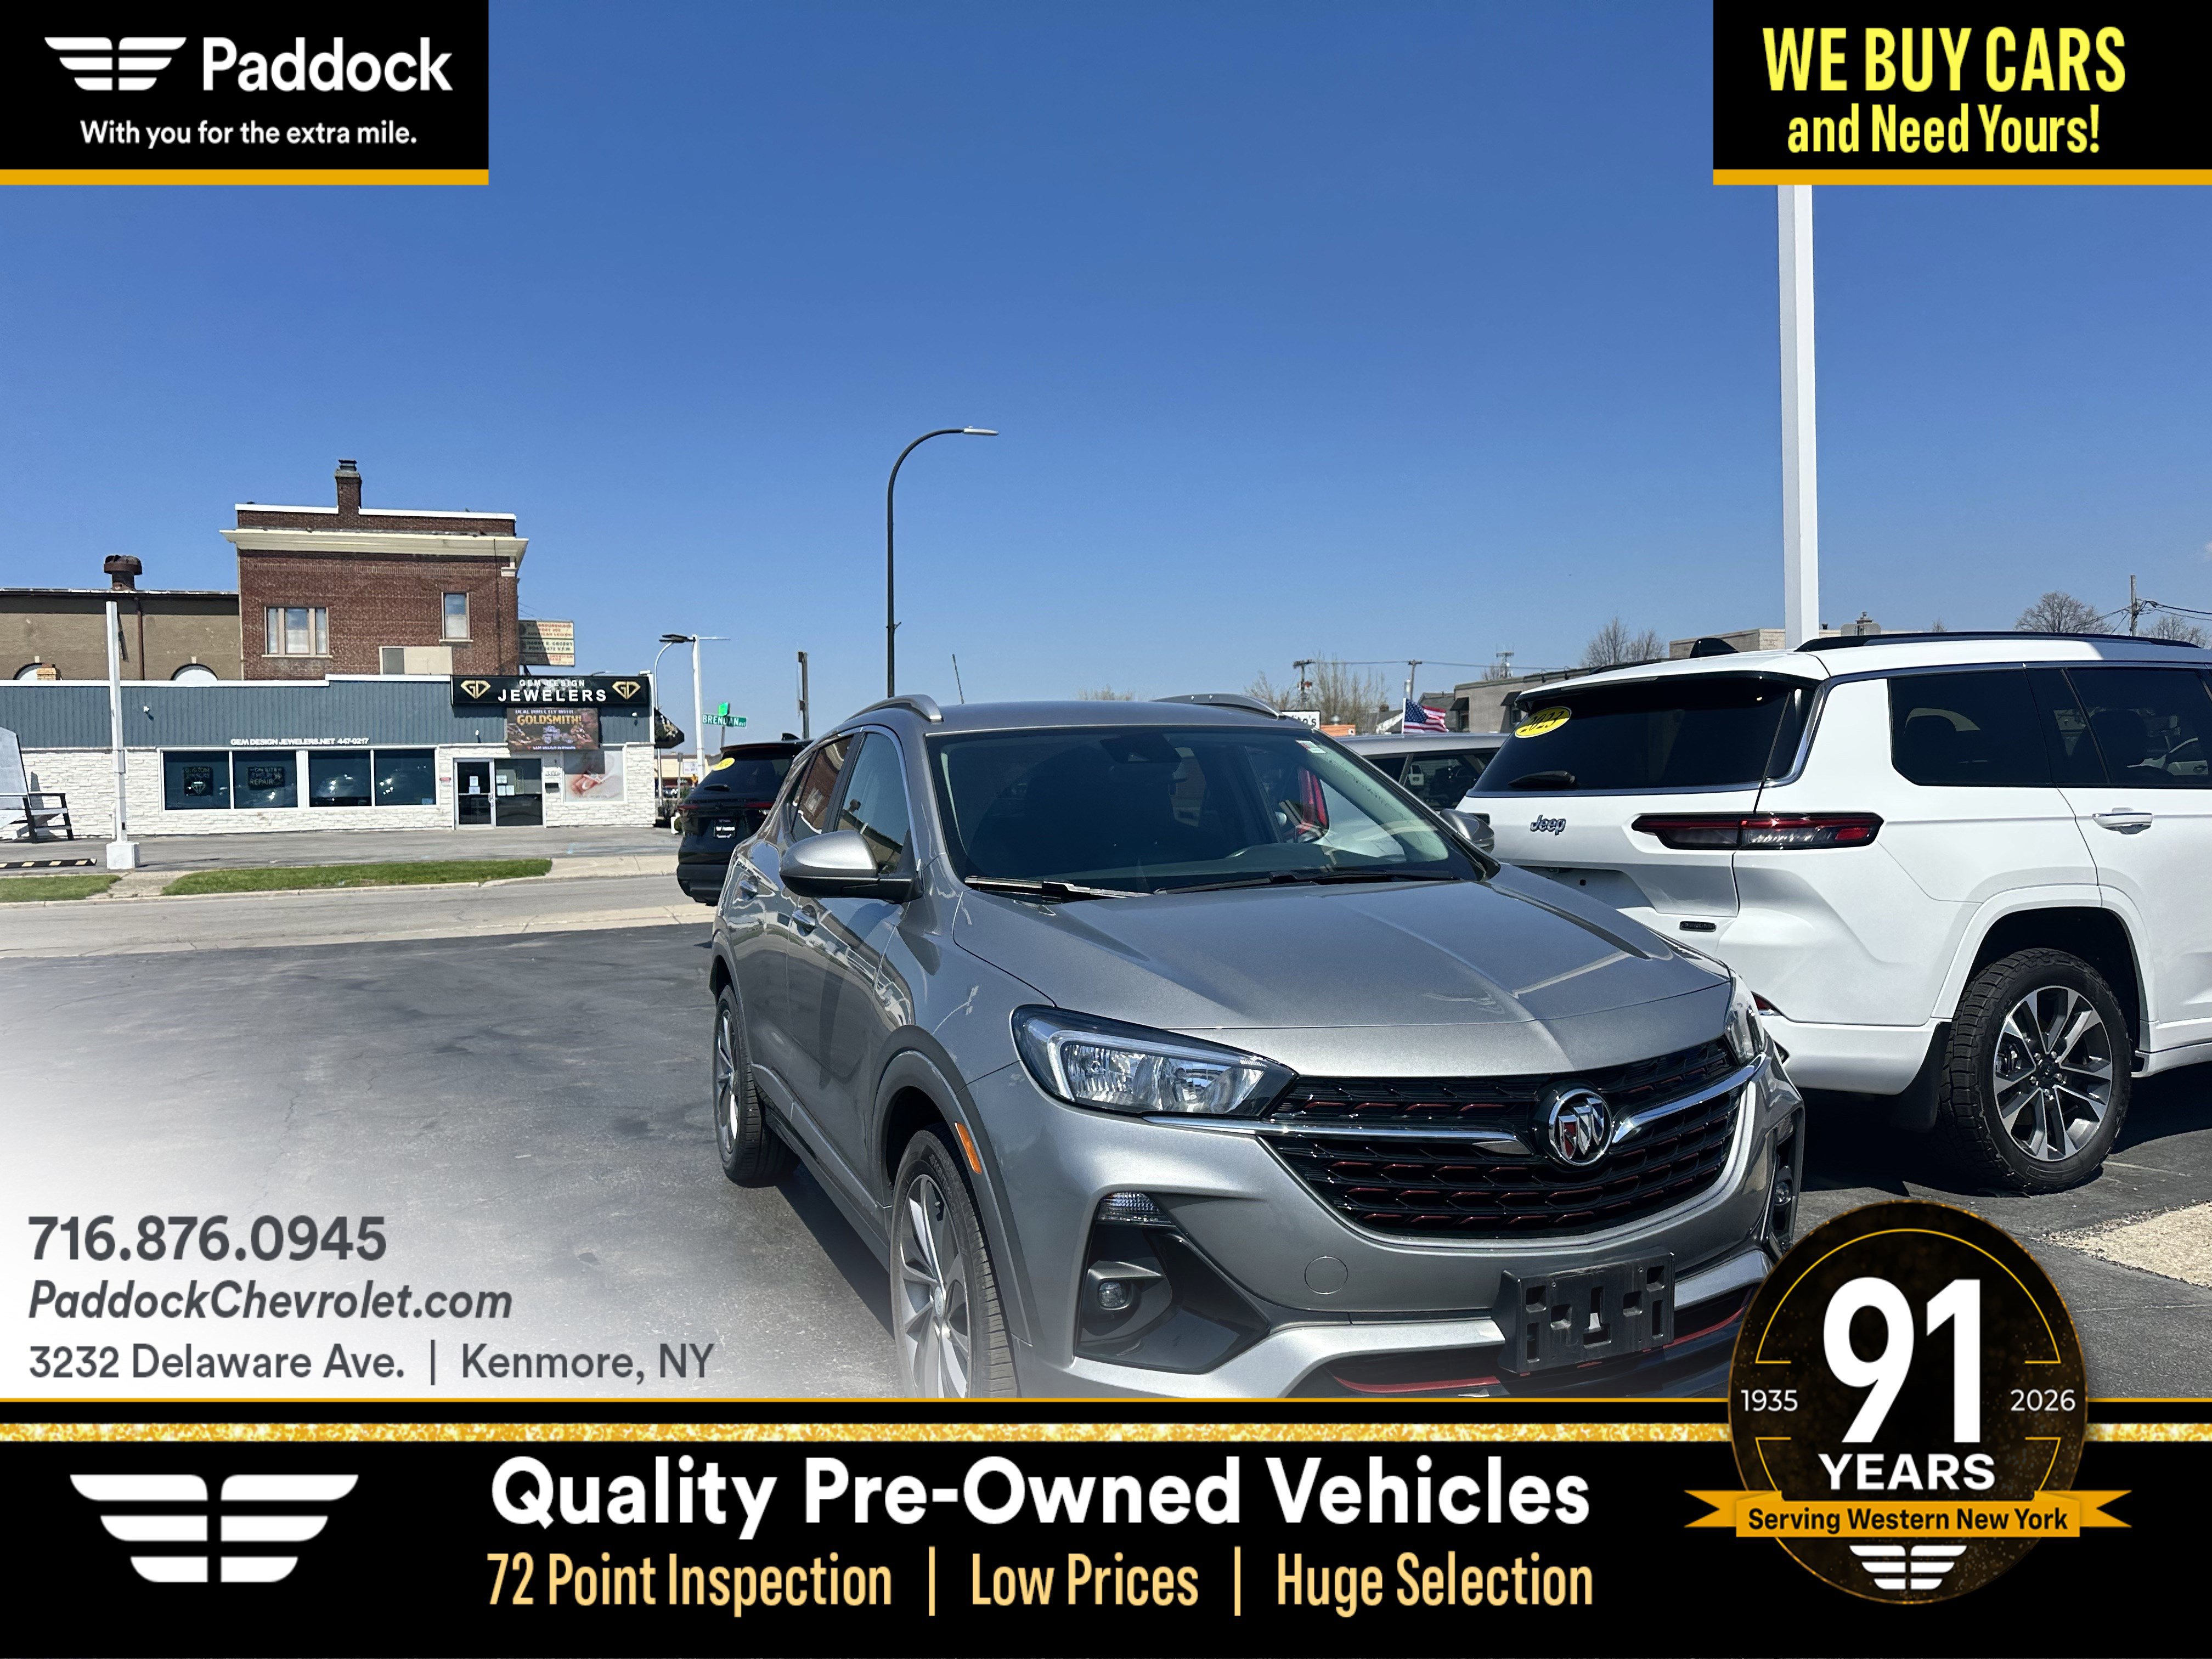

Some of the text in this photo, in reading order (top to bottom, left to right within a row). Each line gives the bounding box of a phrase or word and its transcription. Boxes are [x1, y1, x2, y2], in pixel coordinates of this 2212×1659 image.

[498, 689, 606, 702] JEWELERS
[517, 715, 582, 725] GOLDSMITH!
[702, 714, 739, 726] BRENDAN
[1530, 815, 1566, 836] Jeep
